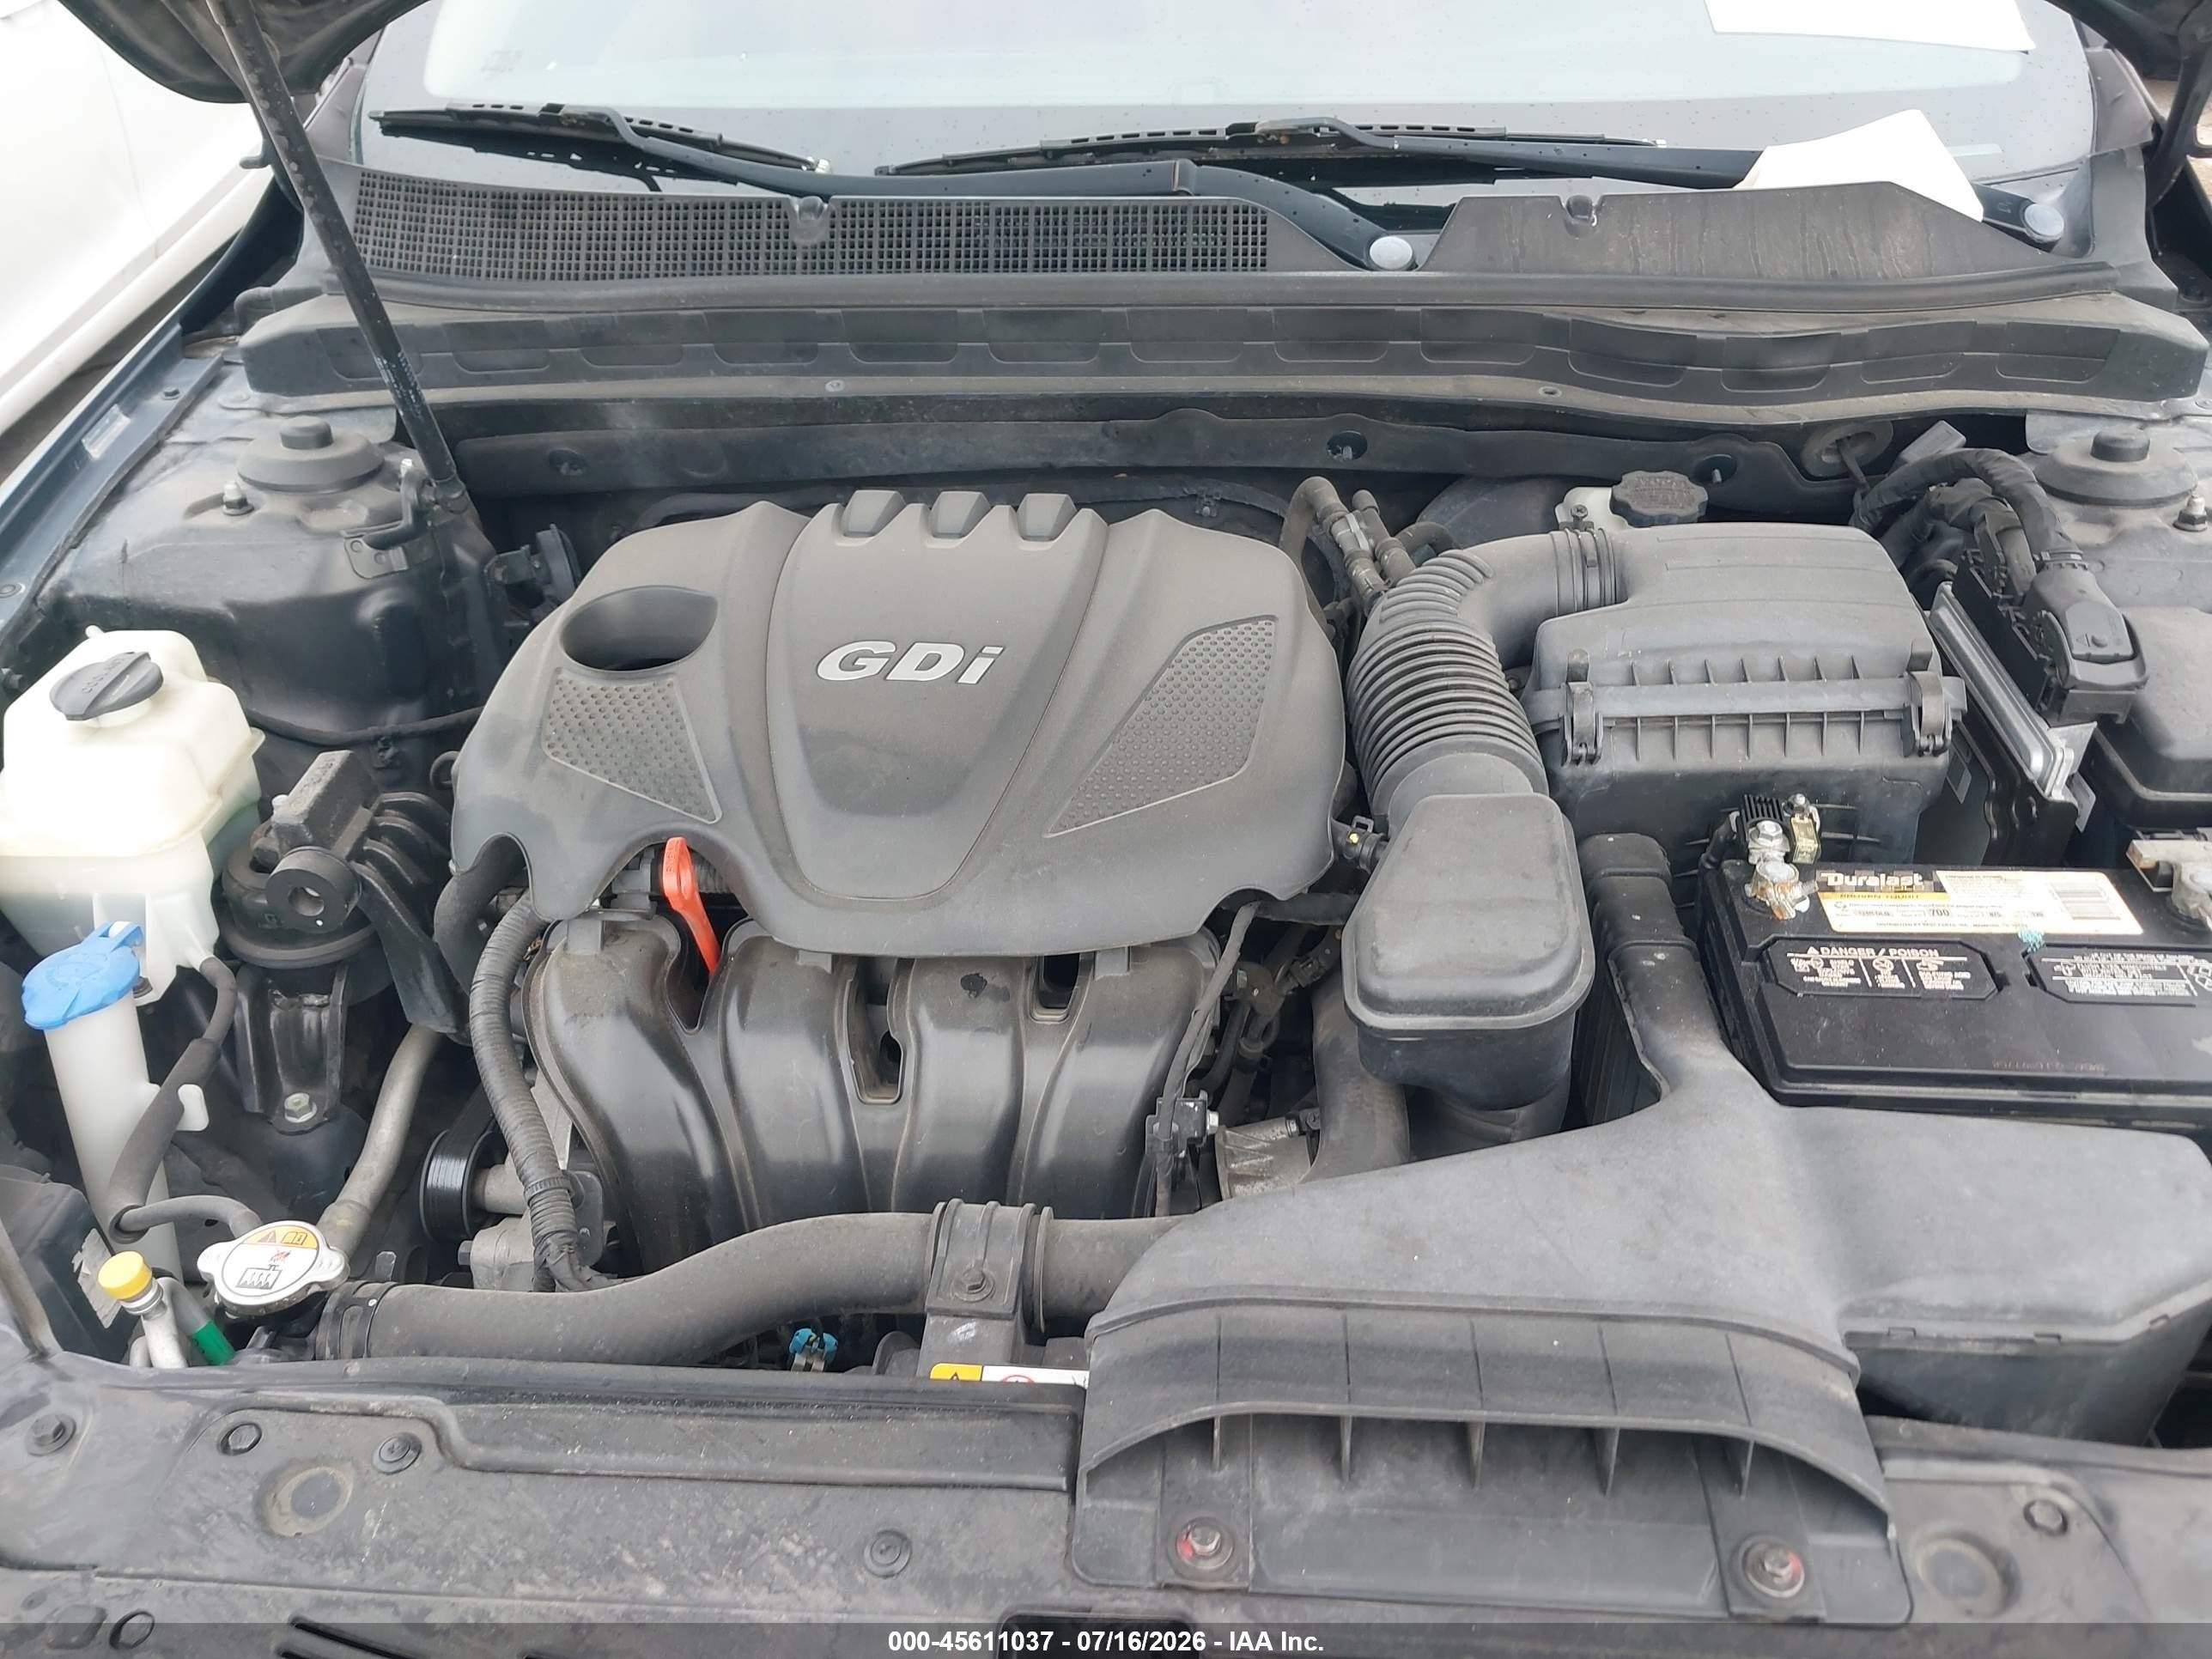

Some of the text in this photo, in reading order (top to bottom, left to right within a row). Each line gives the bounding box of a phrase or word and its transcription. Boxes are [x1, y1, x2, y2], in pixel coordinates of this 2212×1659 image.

[817, 640, 1004, 684] GDi
[1820, 872, 1924, 887] Duralast
[1930, 908, 1950, 917] 700
[1820, 947, 1876, 957] DANGER
[1889, 948, 1940, 957] POISON
